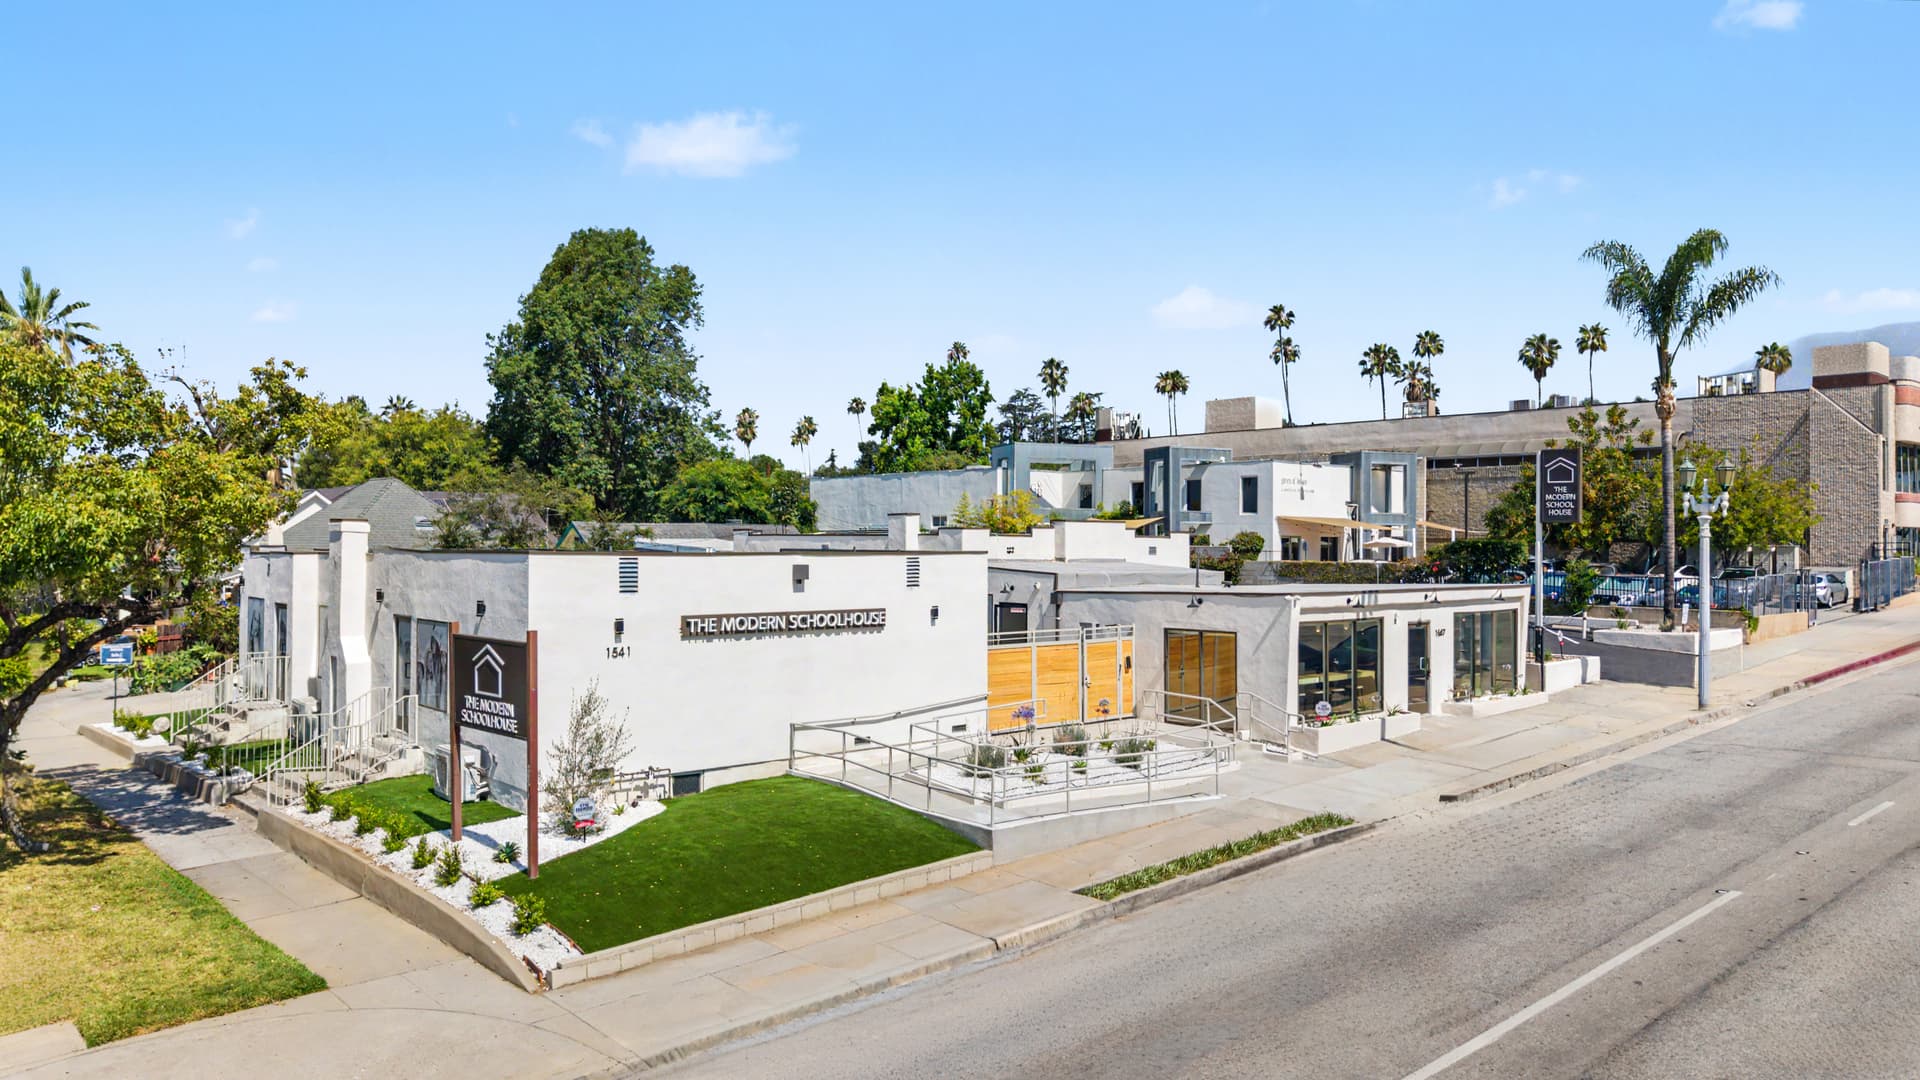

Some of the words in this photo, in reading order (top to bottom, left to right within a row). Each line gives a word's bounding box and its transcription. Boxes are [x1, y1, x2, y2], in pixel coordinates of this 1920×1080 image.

[1545, 501, 1575, 509] SCHOOL
[687, 617, 717, 633] THE
[720, 615, 786, 632] MODERN
[788, 611, 886, 629] SCHOOLHOUSE
[606, 646, 631, 659] 1541
[464, 695, 480, 710] THE
[480, 698, 515, 717] MODERN
[461, 708, 518, 733] SCHOOLHOUSE
